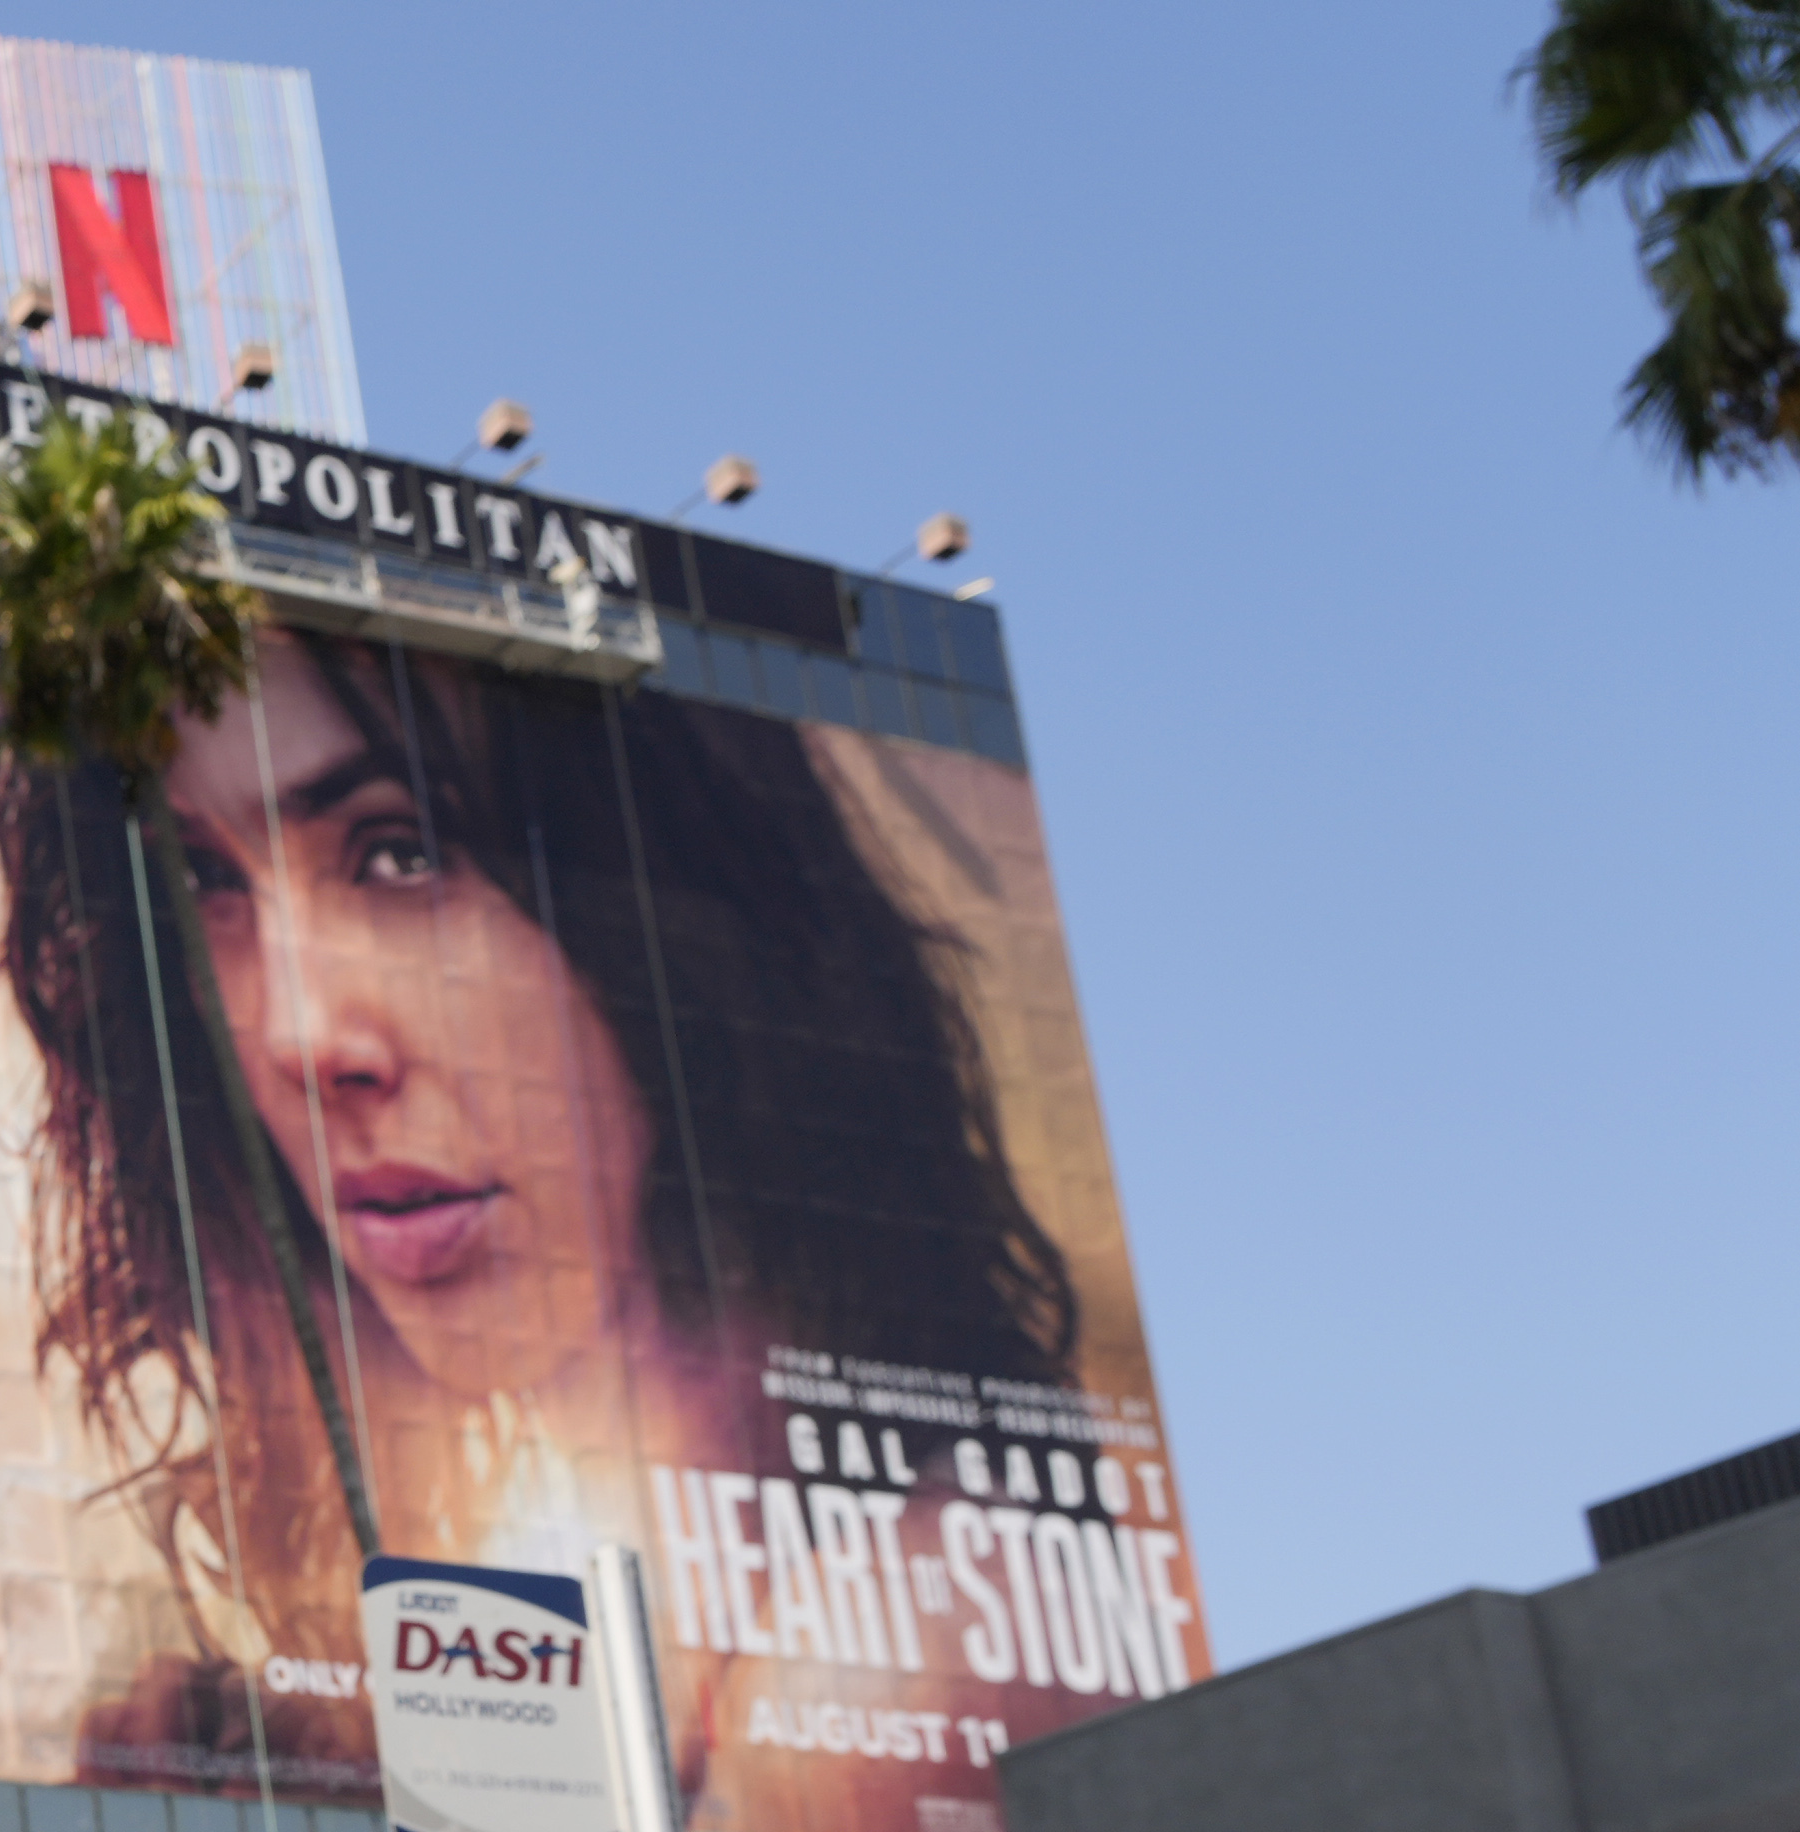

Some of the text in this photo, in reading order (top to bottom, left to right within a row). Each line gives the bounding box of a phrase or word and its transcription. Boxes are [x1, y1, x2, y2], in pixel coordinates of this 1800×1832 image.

[48, 162, 175, 346] N
[786, 1413, 1169, 1521] GAL GADOT
[651, 1463, 924, 1673] HEART
[940, 1501, 1192, 1700] STONE
[264, 1655, 361, 1699] ONLY
[396, 1620, 582, 1687] DASH
[395, 1691, 557, 1727] HOLLYWOOD
[746, 1695, 950, 1763] AUGUST
